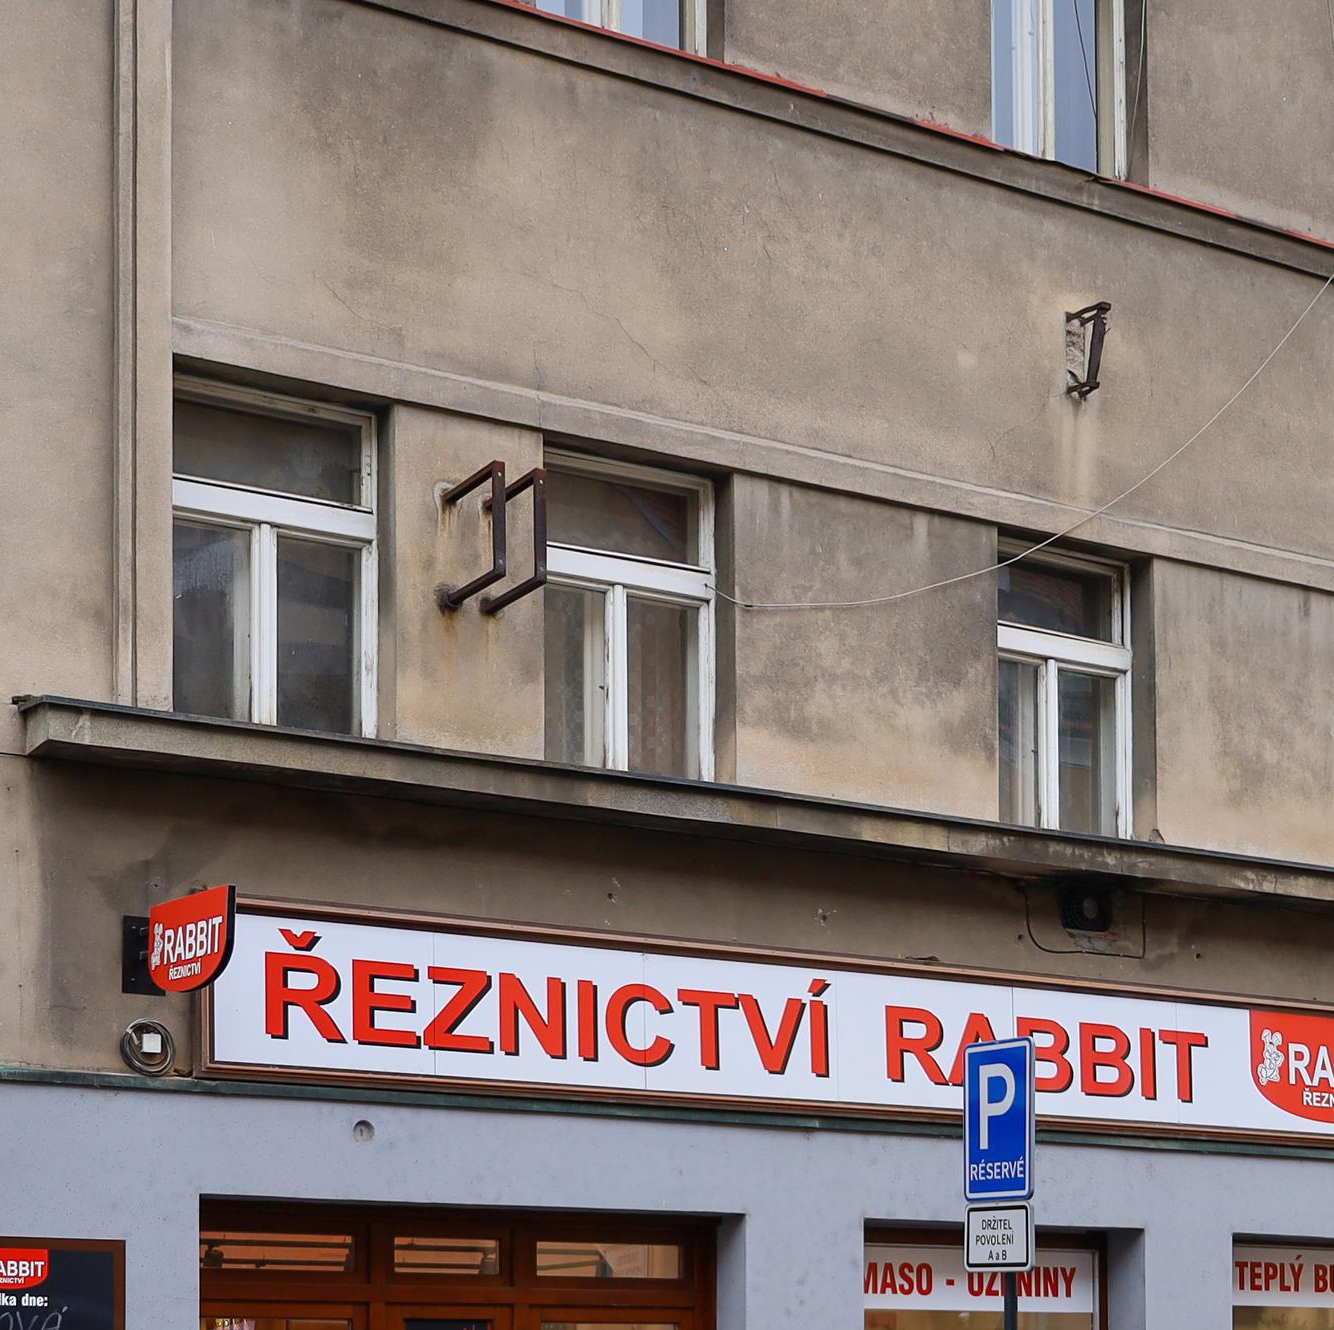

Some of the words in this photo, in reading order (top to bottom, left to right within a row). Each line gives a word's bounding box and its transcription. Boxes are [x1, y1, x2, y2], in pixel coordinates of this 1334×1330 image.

[164, 916, 222, 964] RABBIT
[169, 959, 201, 980] ŘEZNICTVÍ
[264, 928, 830, 1078] ŘEZNICTVÍ
[884, 1004, 1208, 1103] RABBIT
[979, 1063, 1016, 1150] P
[970, 1157, 1025, 1181] RÉSERVÉ
[982, 1216, 1013, 1230] DRŽITEL
[975, 1231, 1014, 1246] POVOLENÍ
[988, 1250, 994, 1261] A
[995, 1252, 1000, 1260] a
[1001, 1250, 1007, 1261] B
[864, 1262, 933, 1296] MASO
[1234, 1253, 1305, 1293] TEPLÝ
[22, 1293, 49, 1307] dne:
